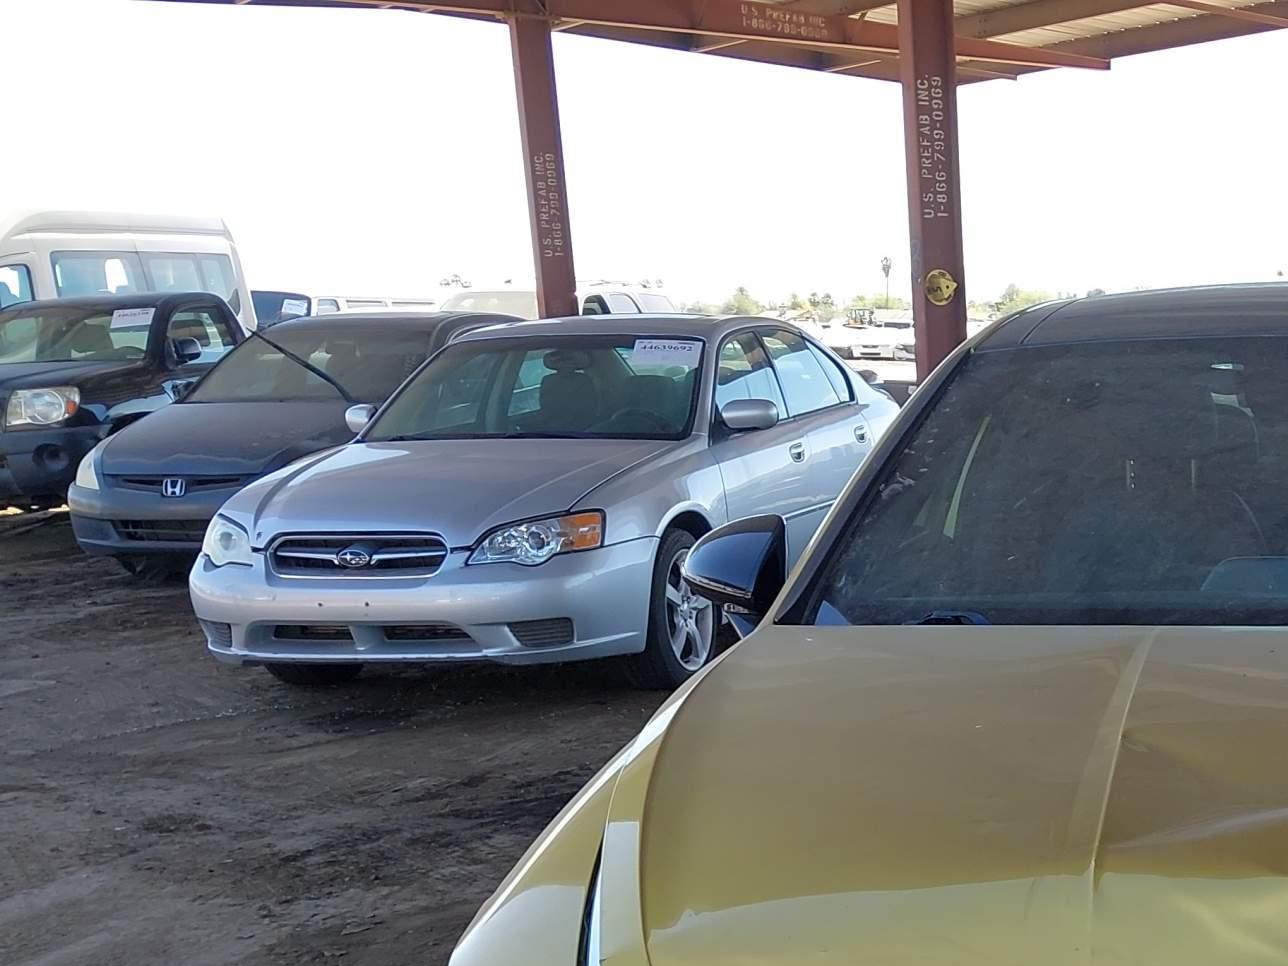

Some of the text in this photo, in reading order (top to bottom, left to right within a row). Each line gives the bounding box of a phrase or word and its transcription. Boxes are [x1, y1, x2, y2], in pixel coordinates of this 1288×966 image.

[537, 181, 551, 228] PREFAB
[917, 74, 935, 218] U.S. PREFAB INC.
[931, 76, 949, 217] 1-866-799-0969
